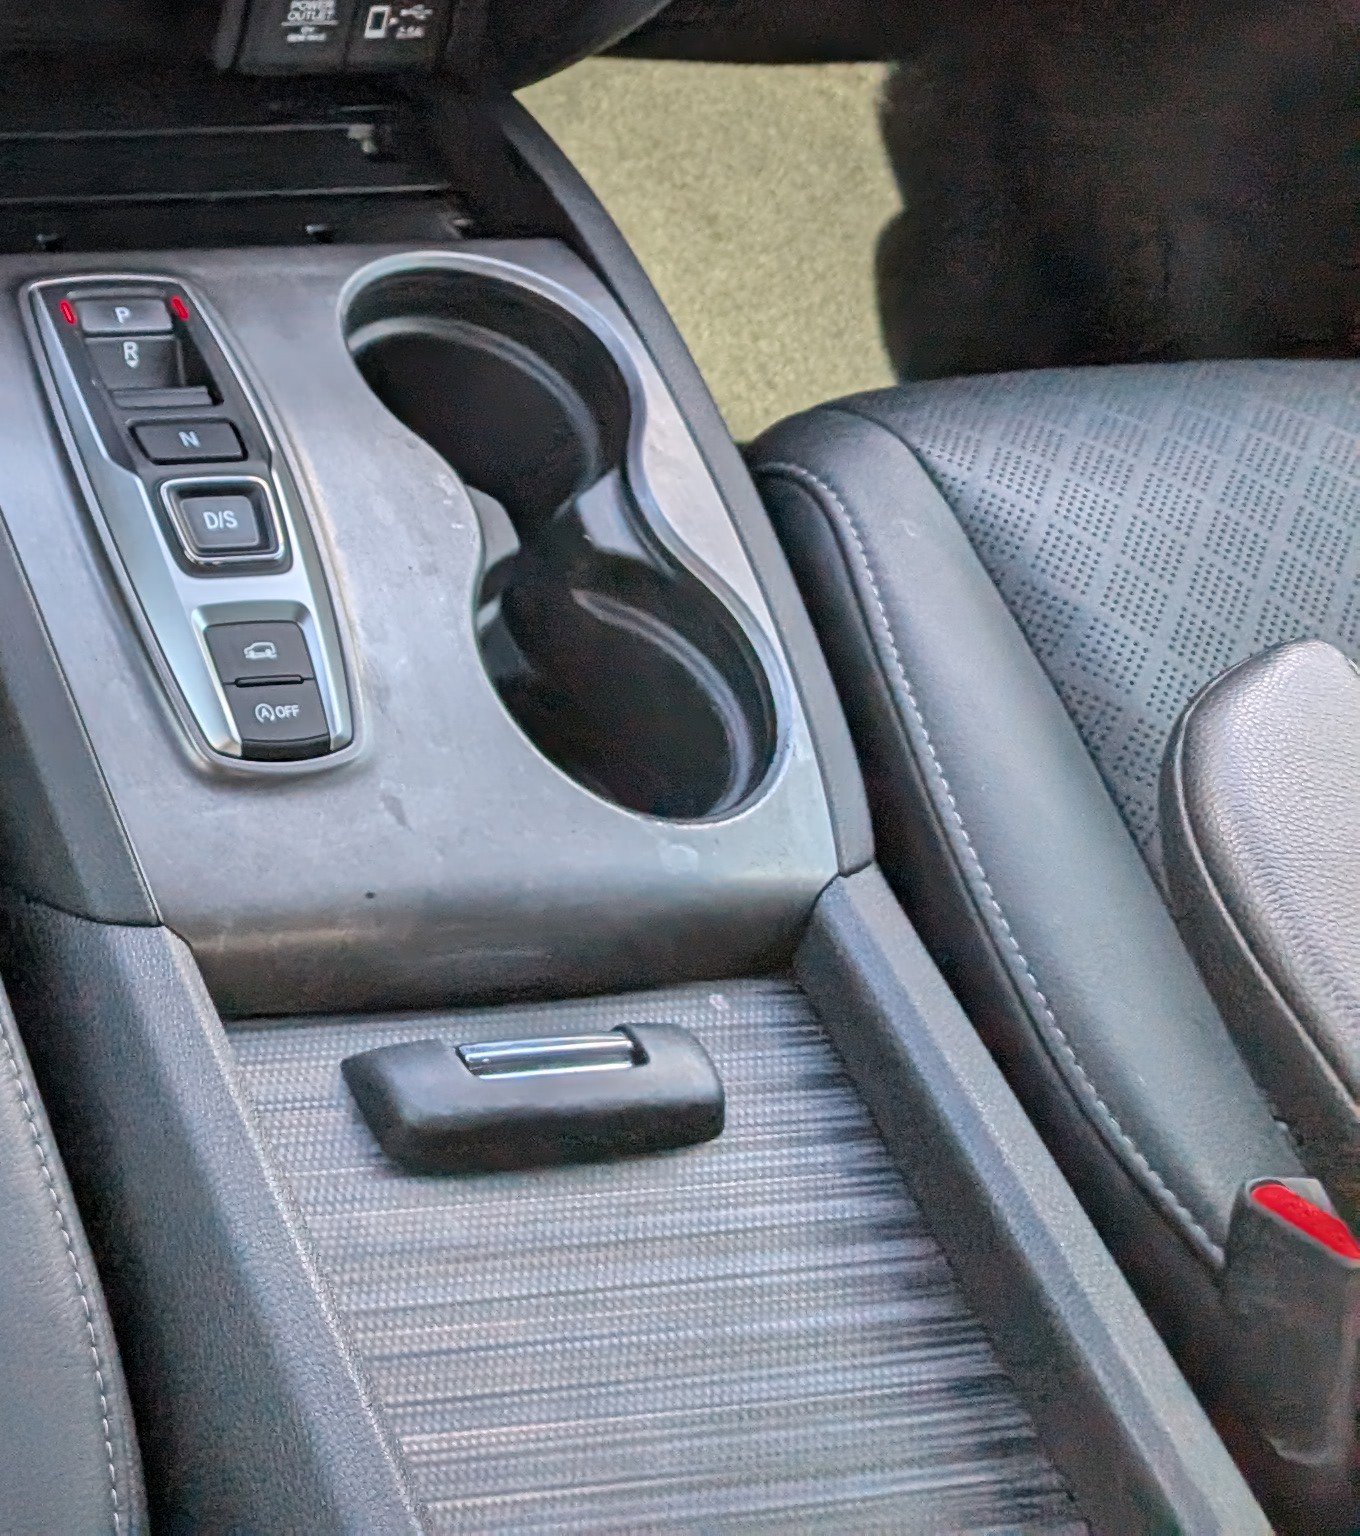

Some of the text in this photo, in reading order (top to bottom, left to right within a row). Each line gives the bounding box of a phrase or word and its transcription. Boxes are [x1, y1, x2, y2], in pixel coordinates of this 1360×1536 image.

[115, 306, 132, 324] P
[123, 341, 139, 360] R
[179, 431, 199, 448] N
[203, 510, 239, 530] D/S
[275, 703, 300, 719] OFF
